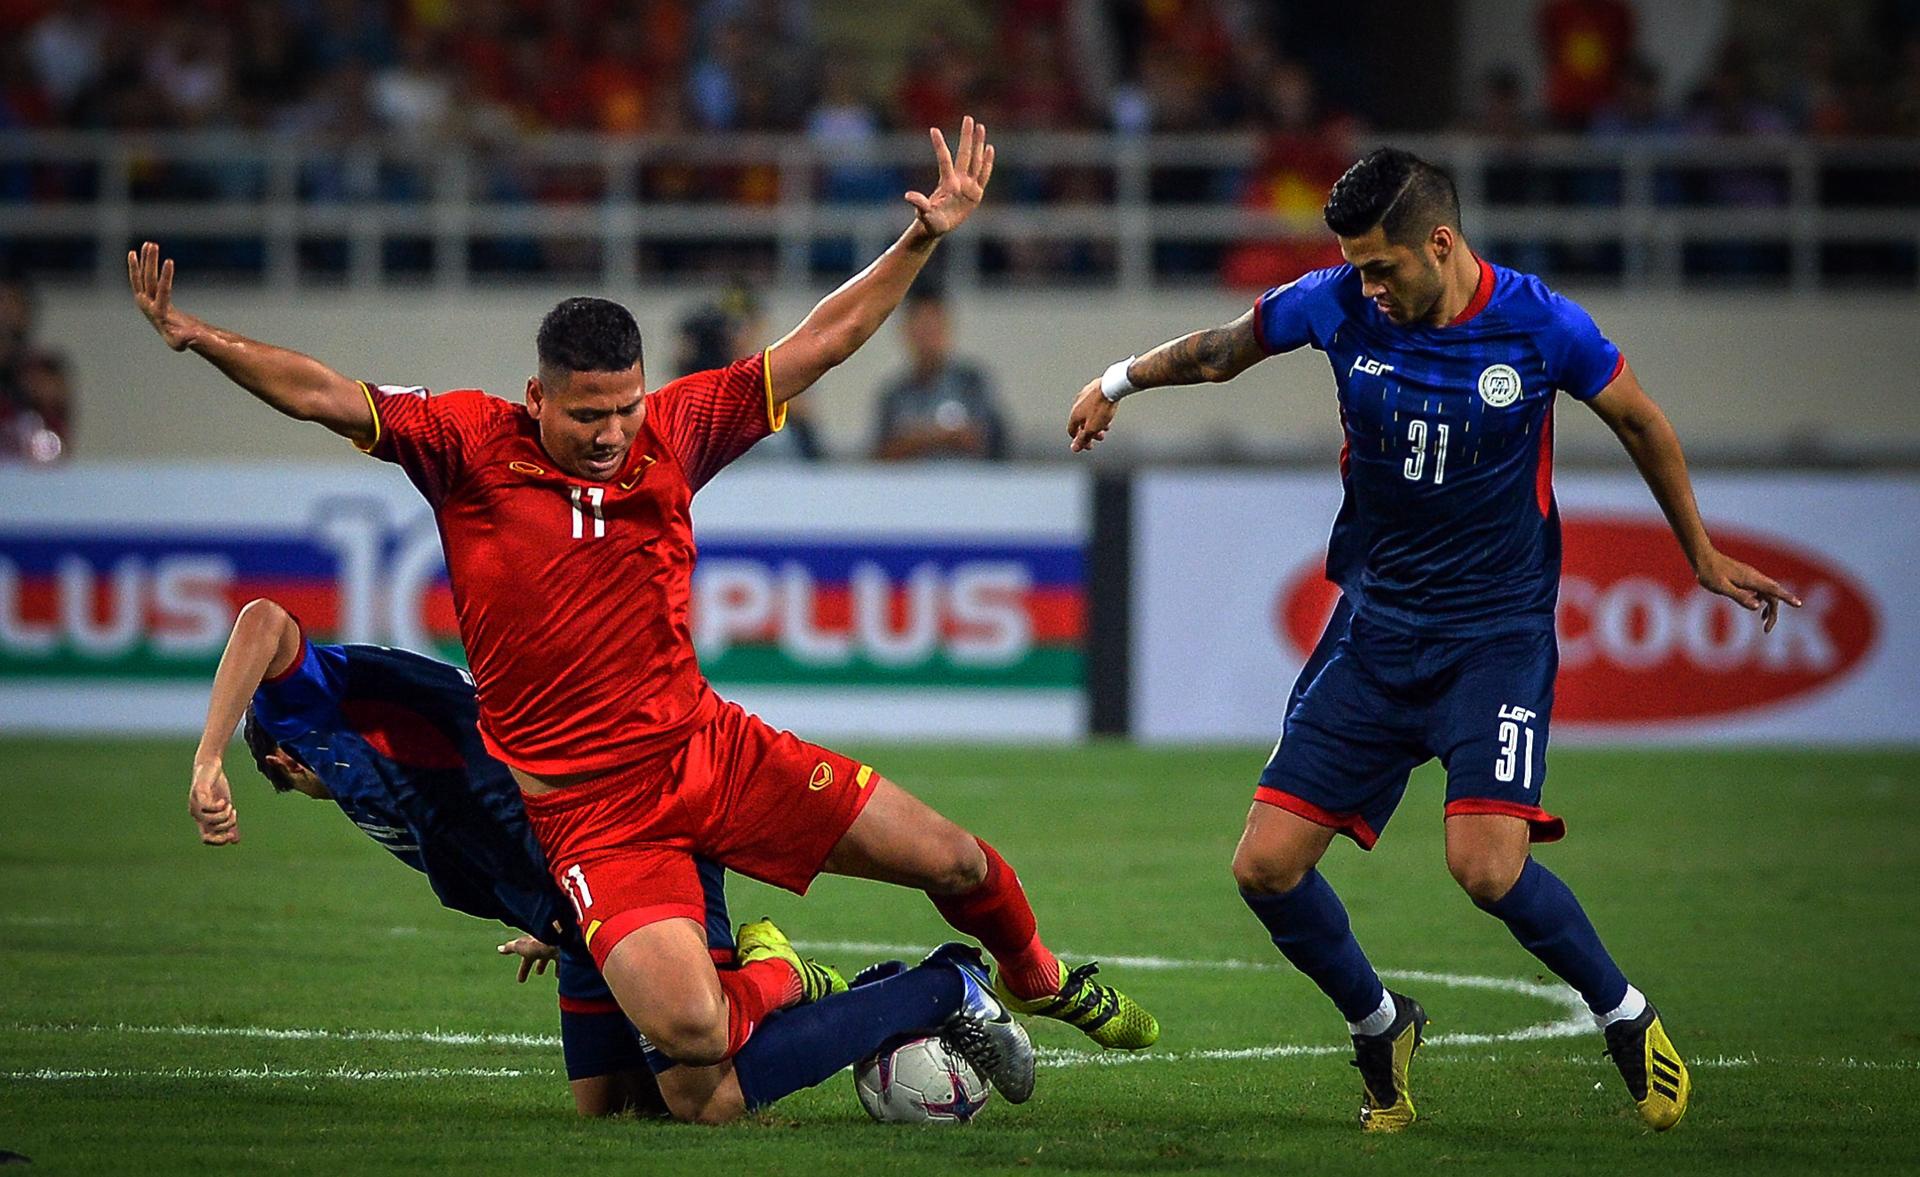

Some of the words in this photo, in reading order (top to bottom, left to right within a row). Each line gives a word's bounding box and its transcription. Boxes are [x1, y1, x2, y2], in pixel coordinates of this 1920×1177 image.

[1403, 419, 1450, 485] 31
[568, 486, 605, 539] 11
[694, 560, 1035, 668] PLUS
[1494, 720, 1534, 790] 31
